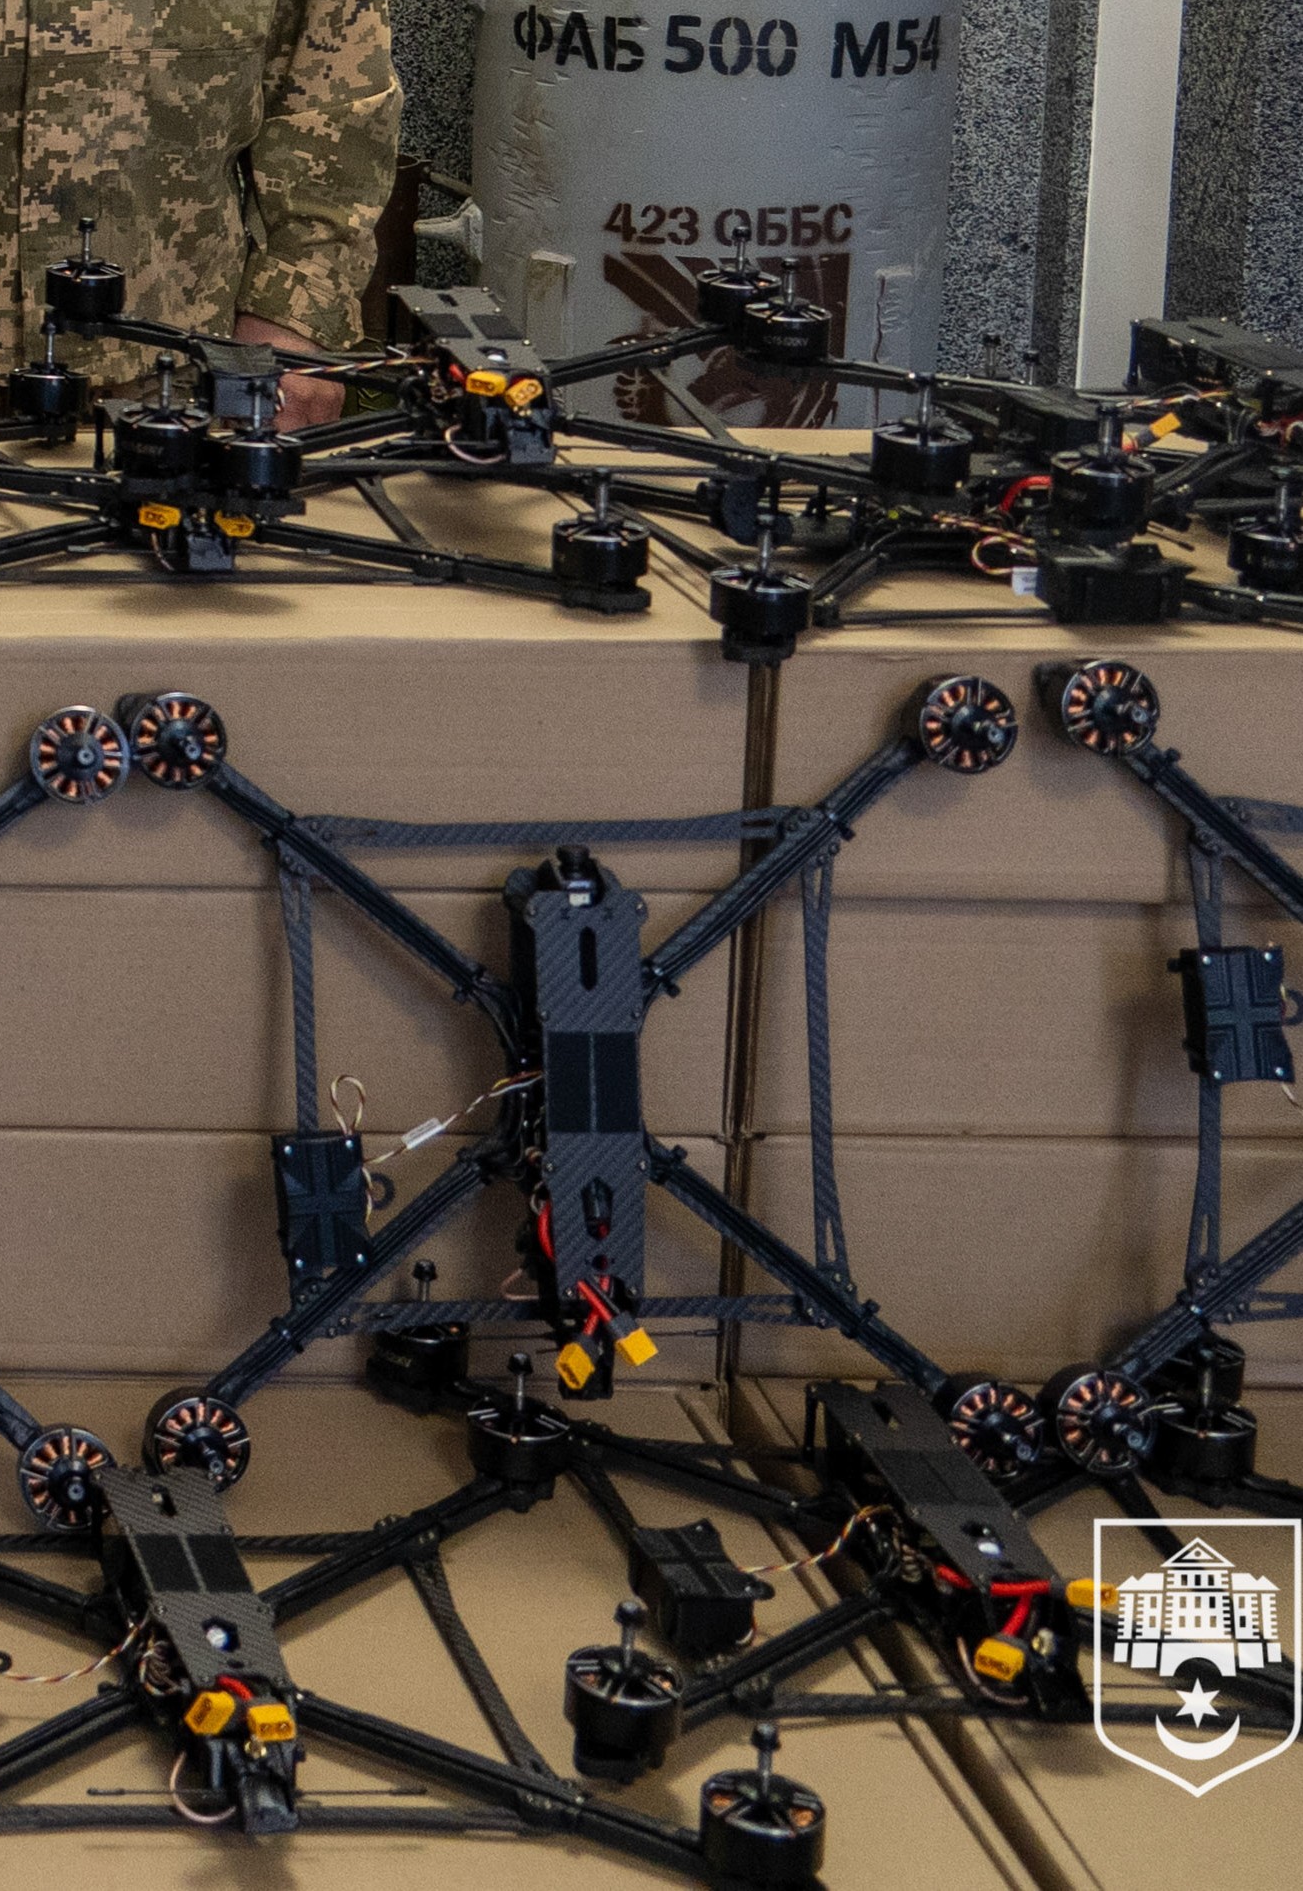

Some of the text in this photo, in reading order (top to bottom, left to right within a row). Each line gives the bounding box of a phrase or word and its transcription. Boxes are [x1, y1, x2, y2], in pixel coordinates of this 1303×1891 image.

[514, 5, 942, 79] ФАБ 500 М54
[603, 203, 853, 247] 423 ОББС
